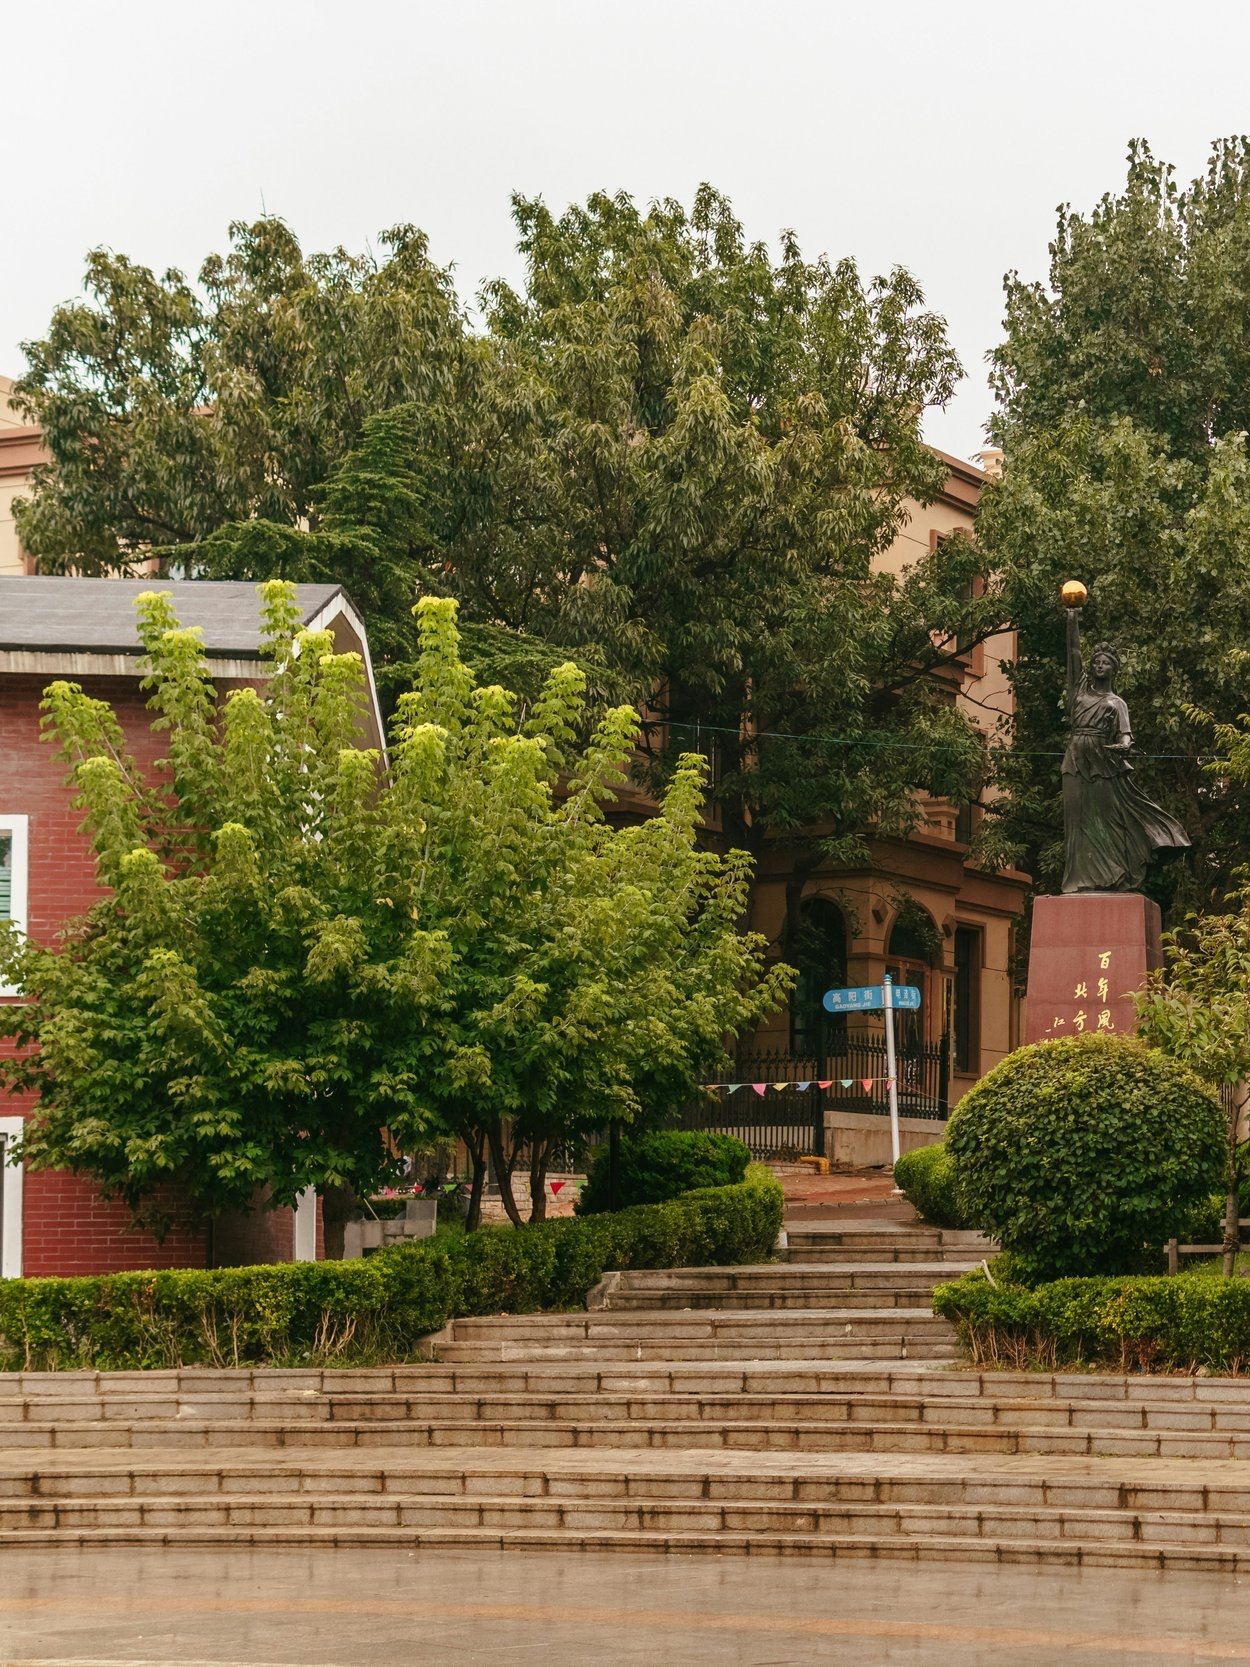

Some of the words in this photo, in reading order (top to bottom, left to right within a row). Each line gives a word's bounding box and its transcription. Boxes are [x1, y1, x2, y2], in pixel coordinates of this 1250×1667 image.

[832, 989, 873, 1003] 高阳街
[1072, 981, 1088, 1031] 北方
